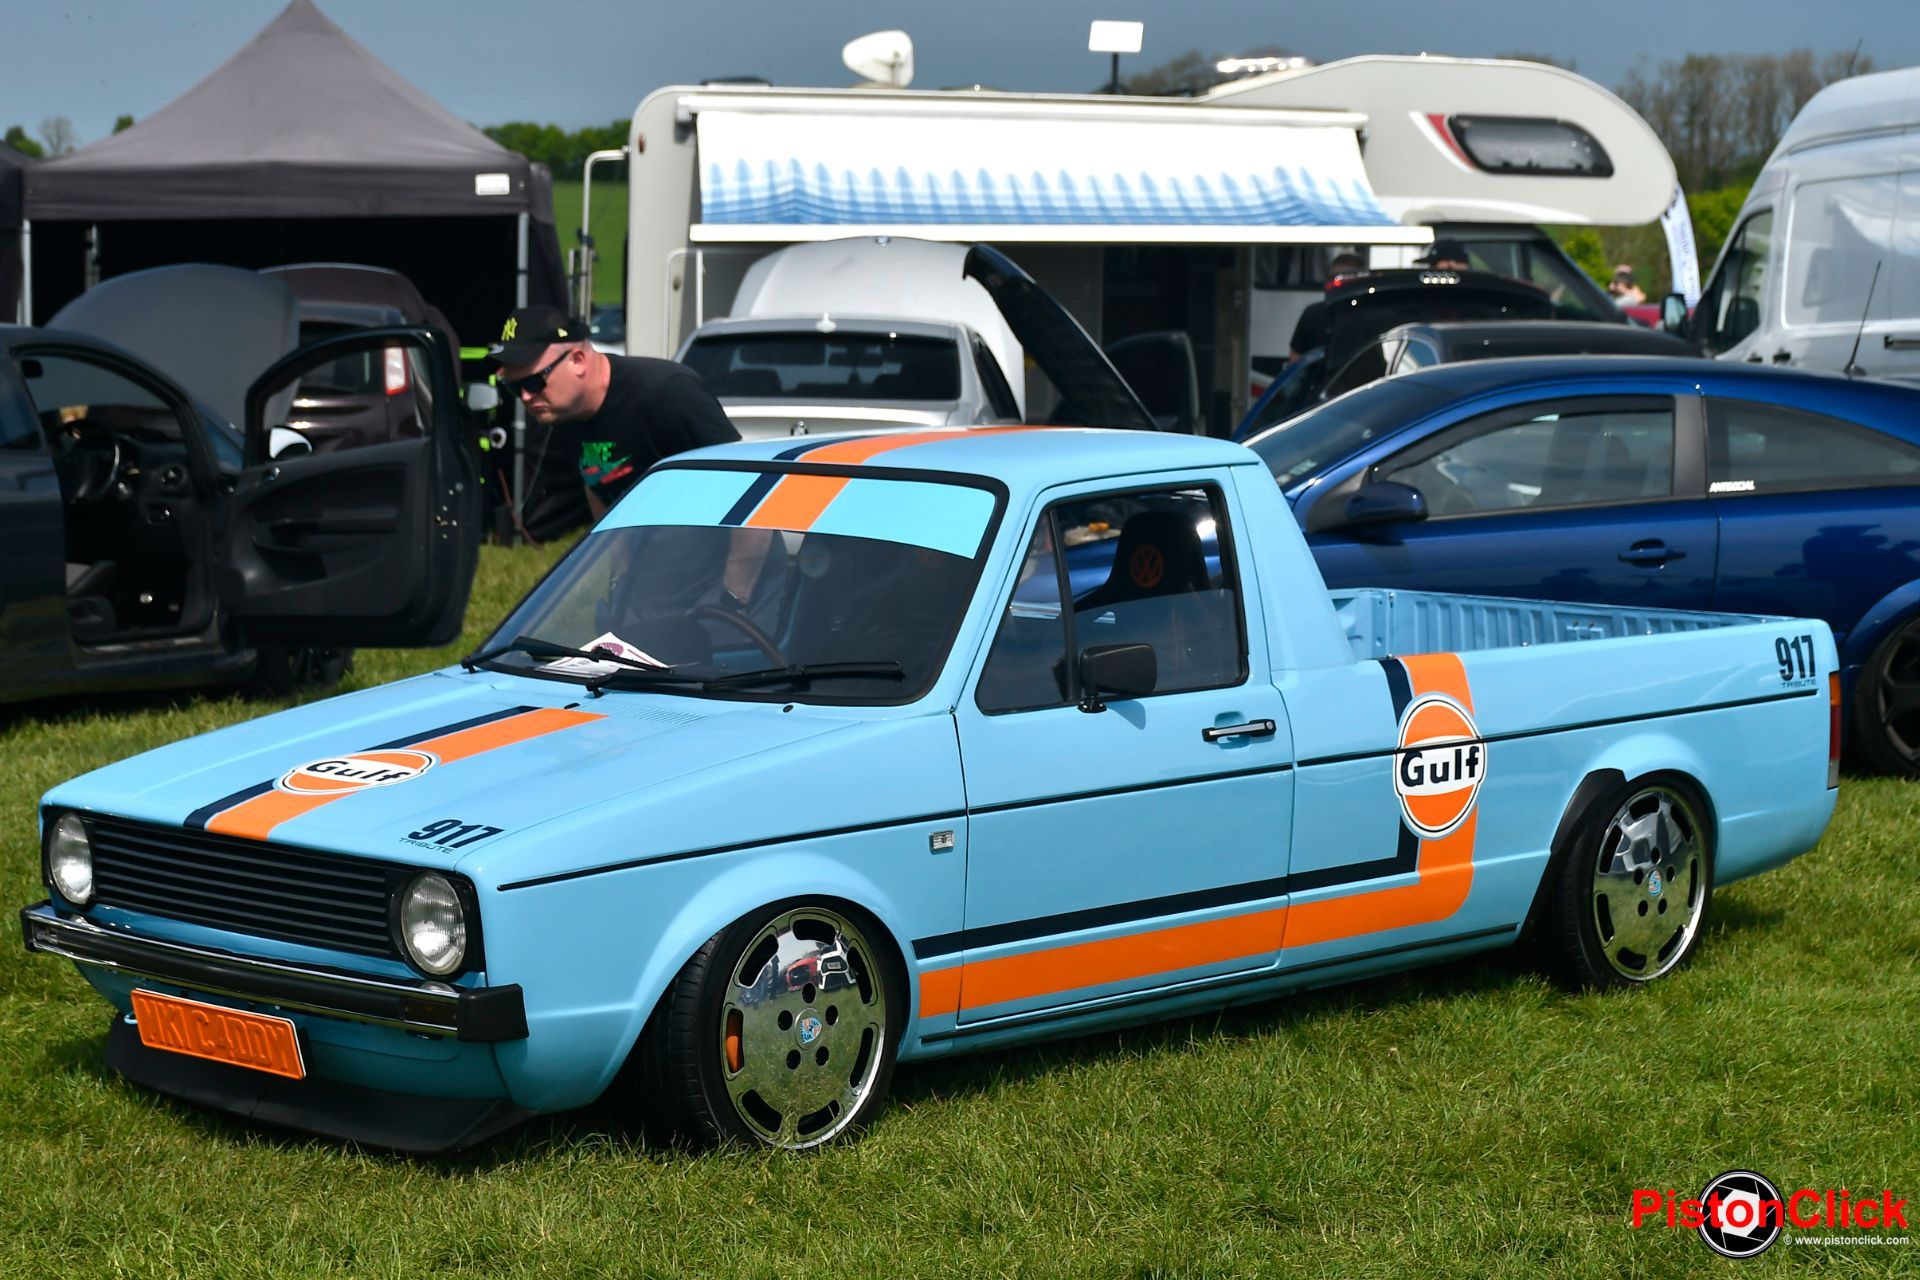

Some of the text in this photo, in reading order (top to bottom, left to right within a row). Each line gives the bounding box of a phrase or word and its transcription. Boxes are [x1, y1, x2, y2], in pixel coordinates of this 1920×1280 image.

[1774, 634, 1816, 682] 917
[306, 760, 411, 782] Gulf
[1400, 745, 1480, 788] Gulf
[399, 837, 455, 854] TRIBUTE
[407, 819, 504, 849] 917
